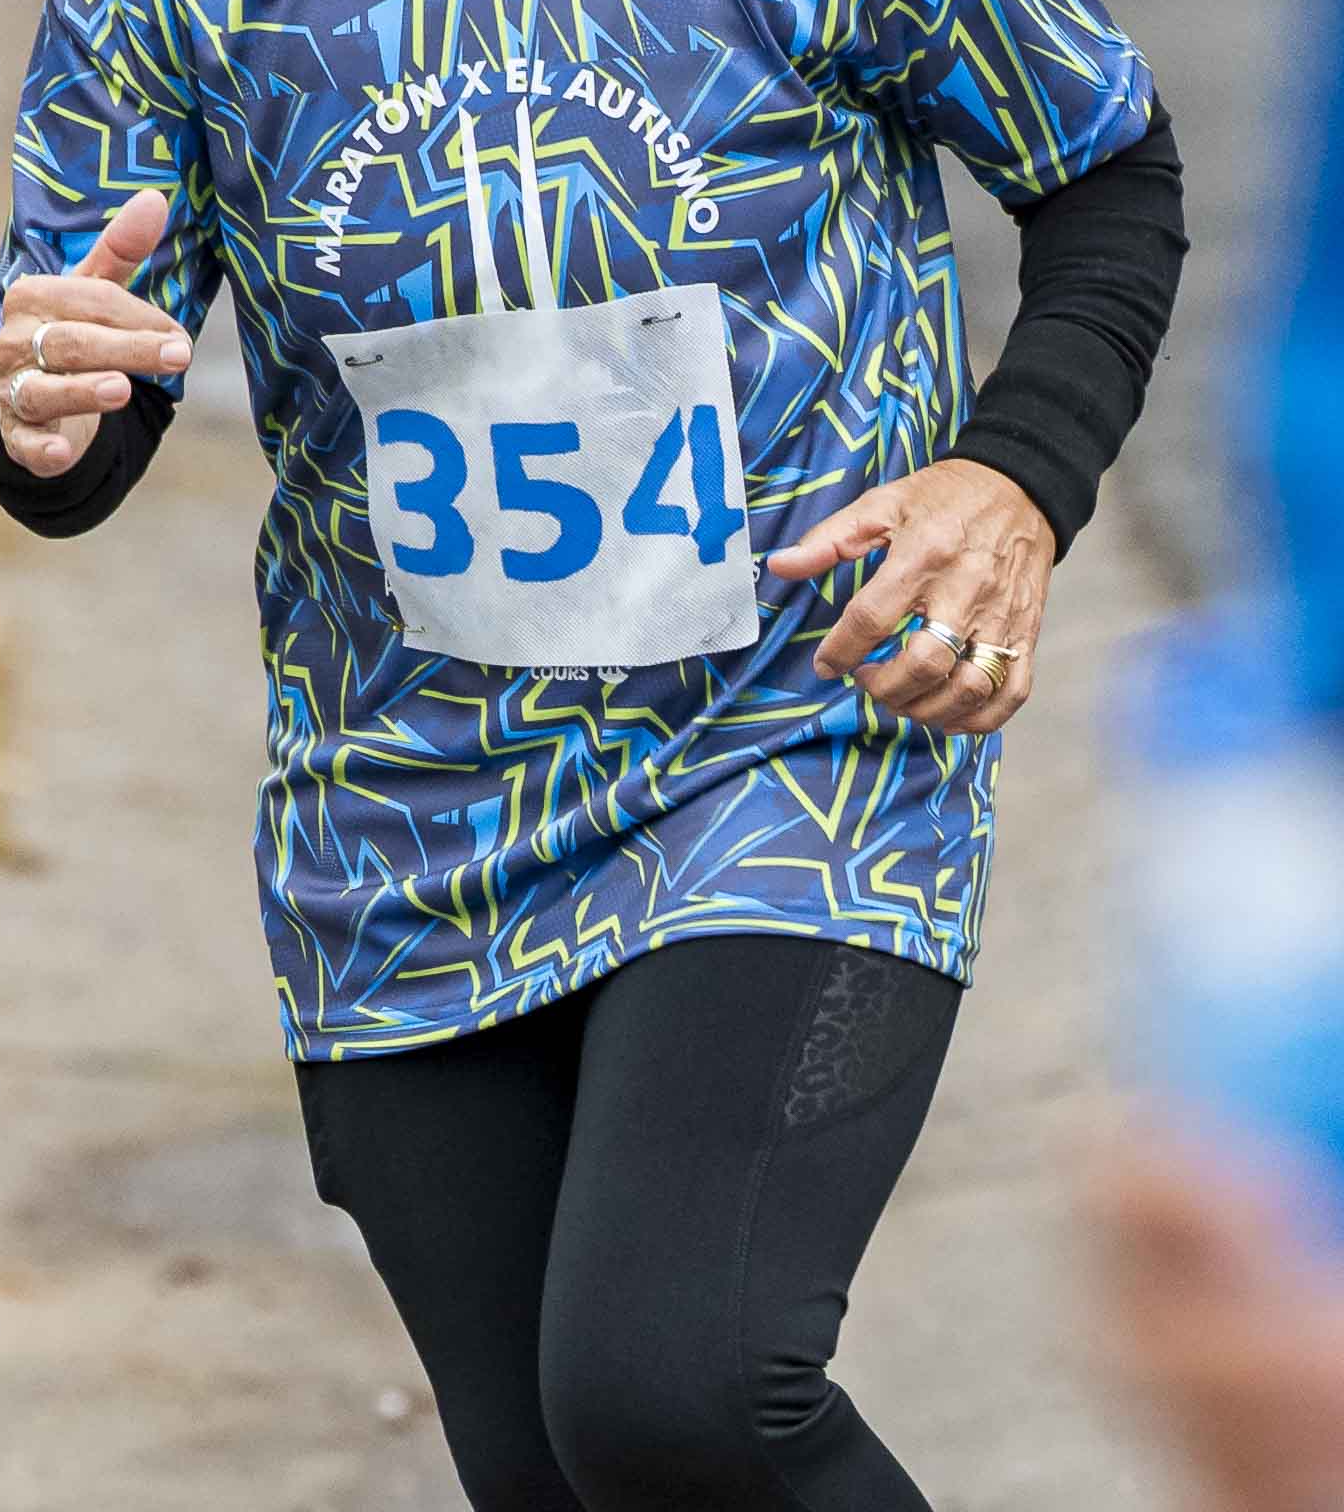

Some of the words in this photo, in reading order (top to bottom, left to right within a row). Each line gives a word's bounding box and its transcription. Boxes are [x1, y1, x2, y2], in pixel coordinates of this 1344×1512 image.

[316, 74, 446, 276] MARATÓN
[457, 61, 492, 98] X
[506, 58, 552, 96] EL
[562, 68, 719, 234] AUTISMO
[376, 404, 744, 582] 354
